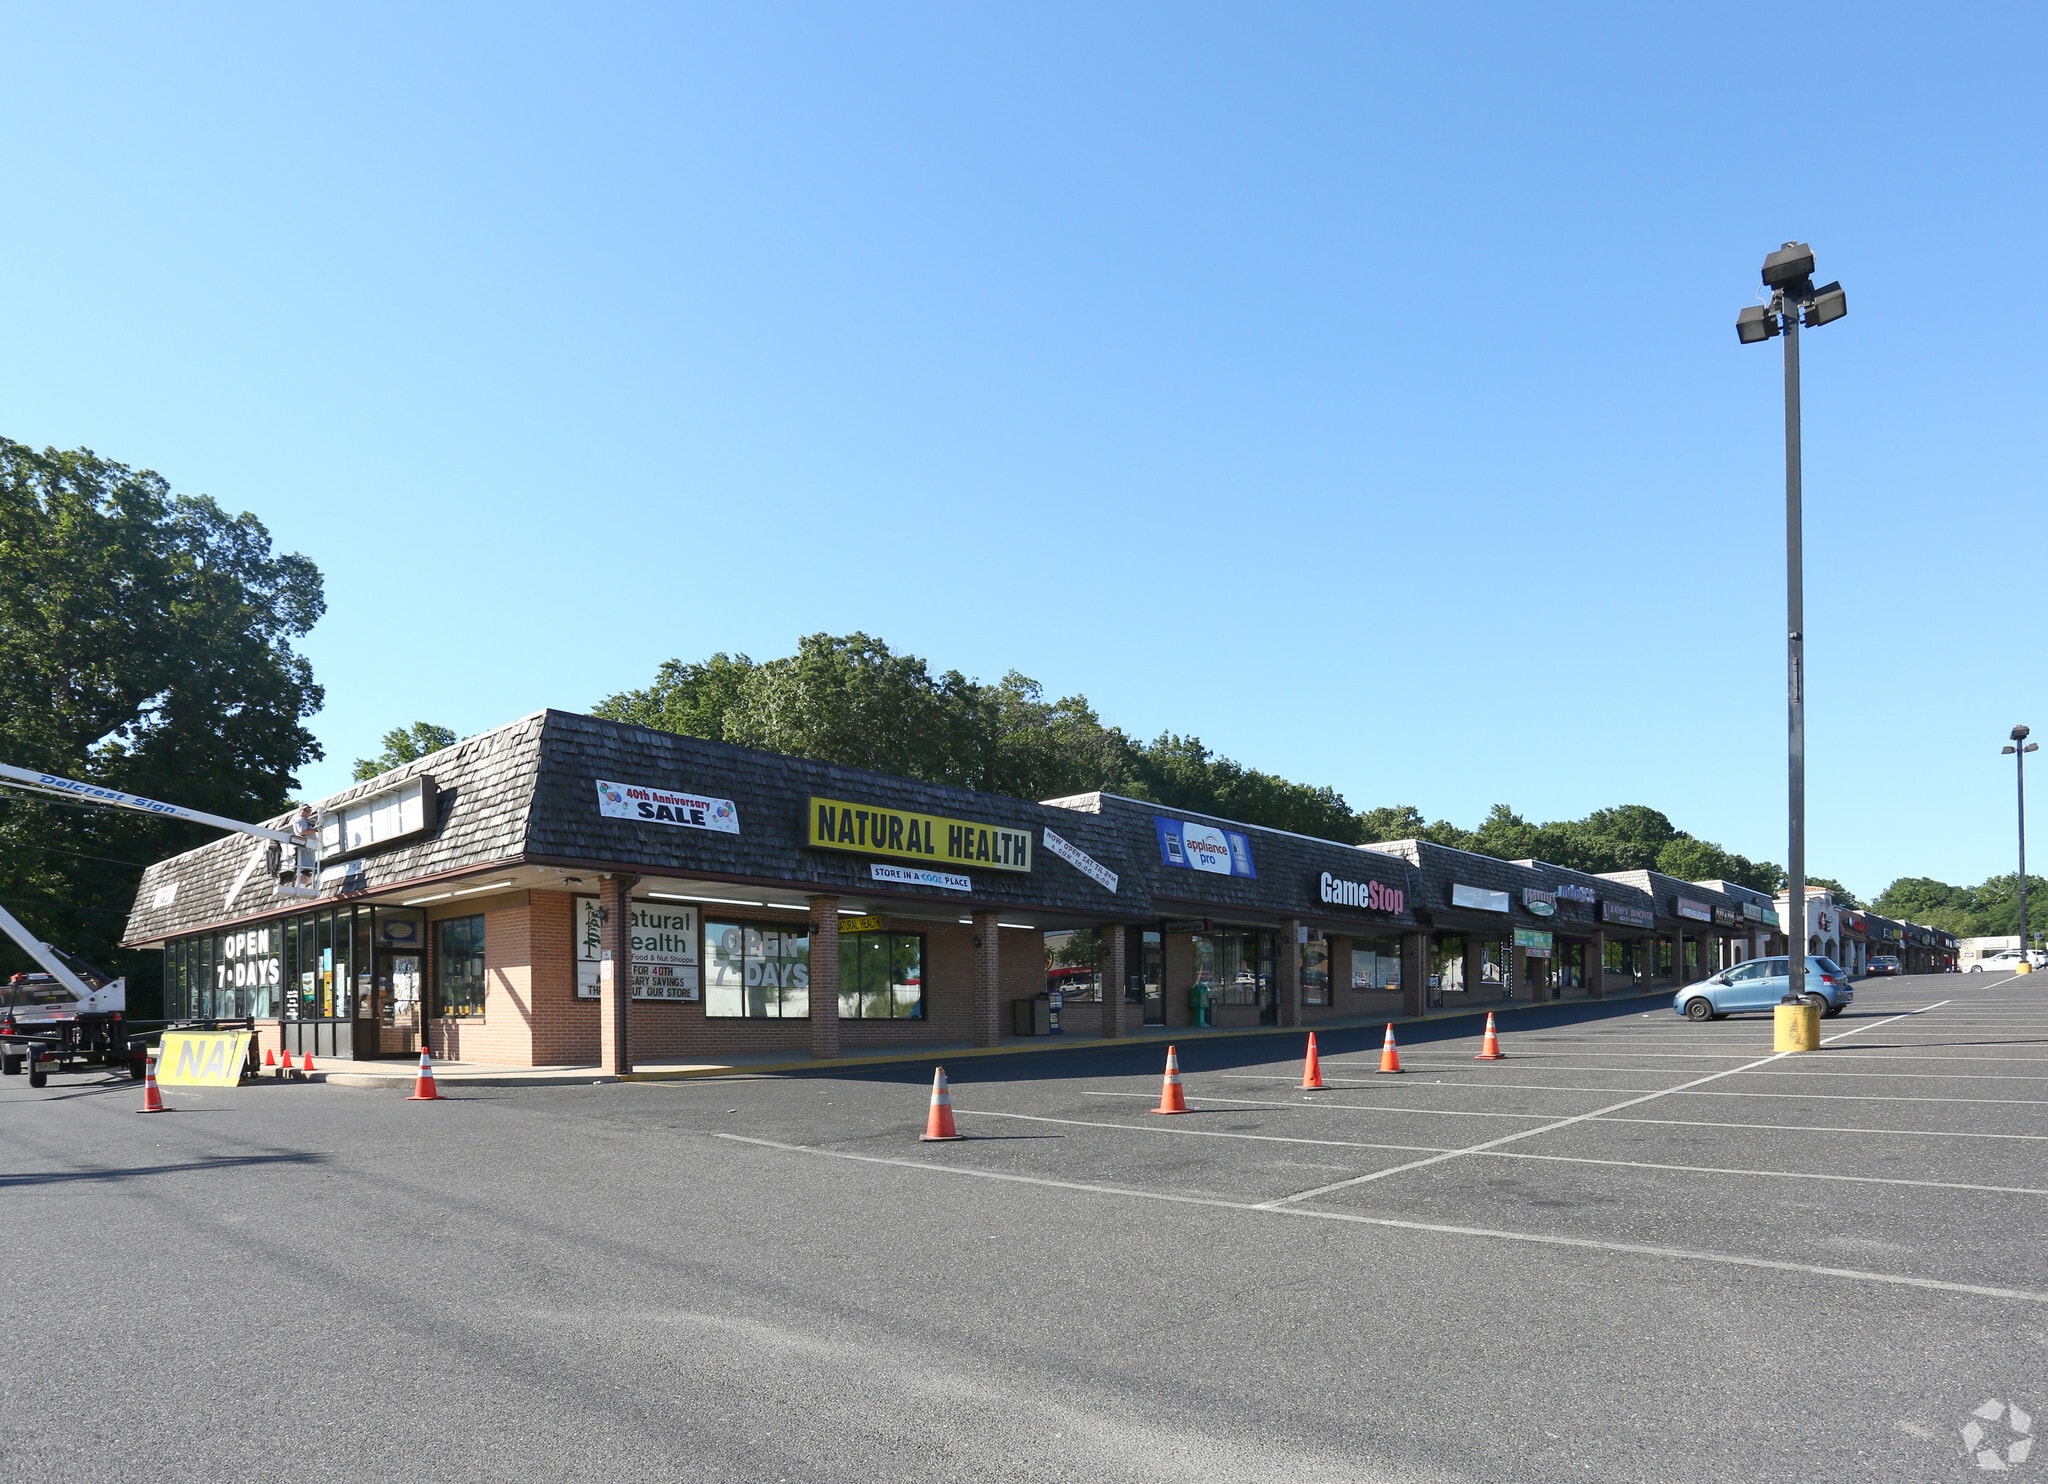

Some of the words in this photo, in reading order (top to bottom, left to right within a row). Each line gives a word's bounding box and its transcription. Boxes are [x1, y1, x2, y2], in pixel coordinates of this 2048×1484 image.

[39, 774, 125, 801] Delcrest
[626, 788, 650, 801] 40th
[652, 792, 711, 811] Anniversary
[637, 801, 706, 826] SALE
[818, 804, 935, 854] NATURAL
[948, 824, 1026, 867] HEALTH
[1046, 832, 1063, 846] NOW
[1063, 843, 1081, 858] OPEN
[1186, 839, 1228, 855] appliance
[1200, 853, 1216, 865] pro
[874, 868, 901, 878] STORE
[903, 871, 912, 879] IN
[921, 874, 943, 884] COOL
[944, 876, 968, 887] PLACE
[1320, 871, 1404, 915] GameStop
[632, 909, 690, 931] atural
[838, 919, 859, 931] ATURAL
[860, 916, 880, 929] HEALTH
[225, 928, 269, 959] OPEN
[632, 933, 686, 953] ealth
[721, 928, 798, 958] OPEN
[633, 965, 649, 975] FOR
[652, 966, 674, 977] 40TH
[652, 976, 685, 987] SAVINGS
[744, 960, 809, 989] DAYS
[647, 987, 664, 997] OUR
[667, 988, 692, 998] STORE
